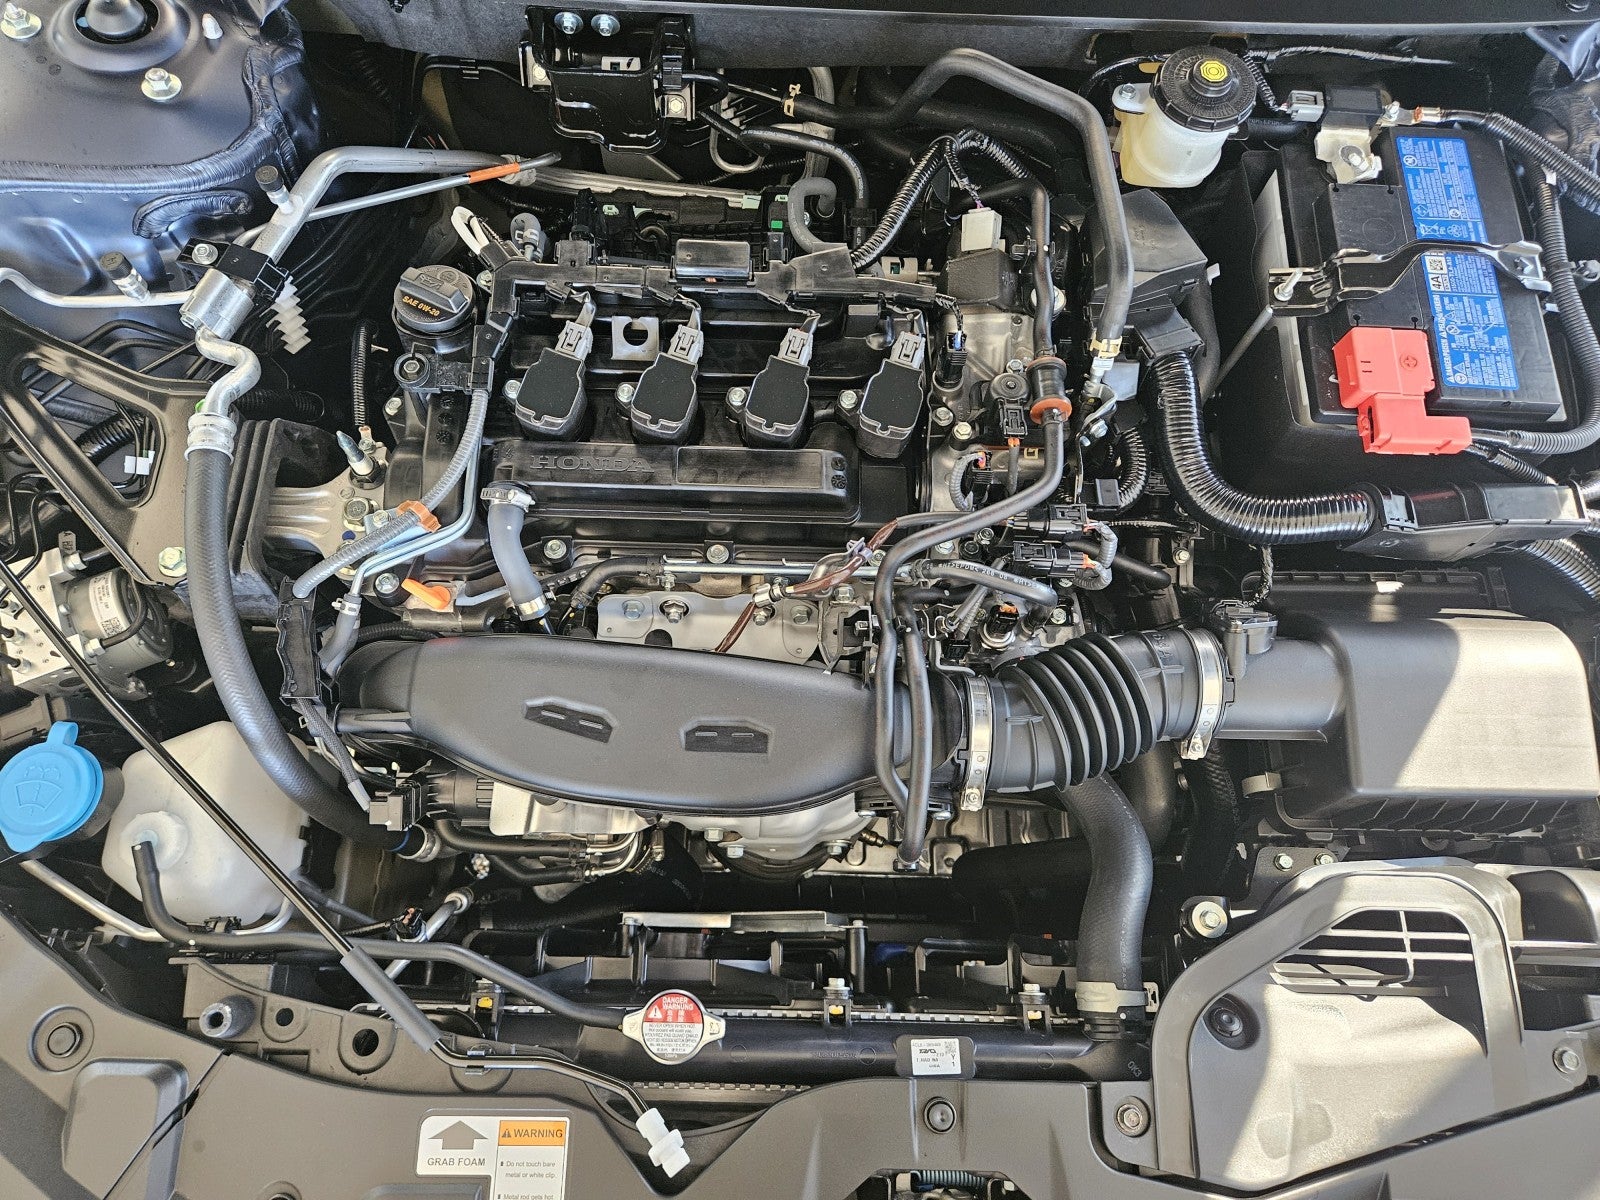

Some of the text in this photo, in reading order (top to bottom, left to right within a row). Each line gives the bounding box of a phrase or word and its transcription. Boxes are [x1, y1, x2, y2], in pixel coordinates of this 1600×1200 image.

[1430, 275, 1443, 290] 4A
[402, 295, 419, 307] SAE
[417, 302, 440, 317] 0W-20
[530, 455, 655, 473] HONDA
[662, 996, 688, 1004] DANGER
[514, 1129, 563, 1138] WARNING
[427, 1157, 486, 1167] GRAB FOAM
